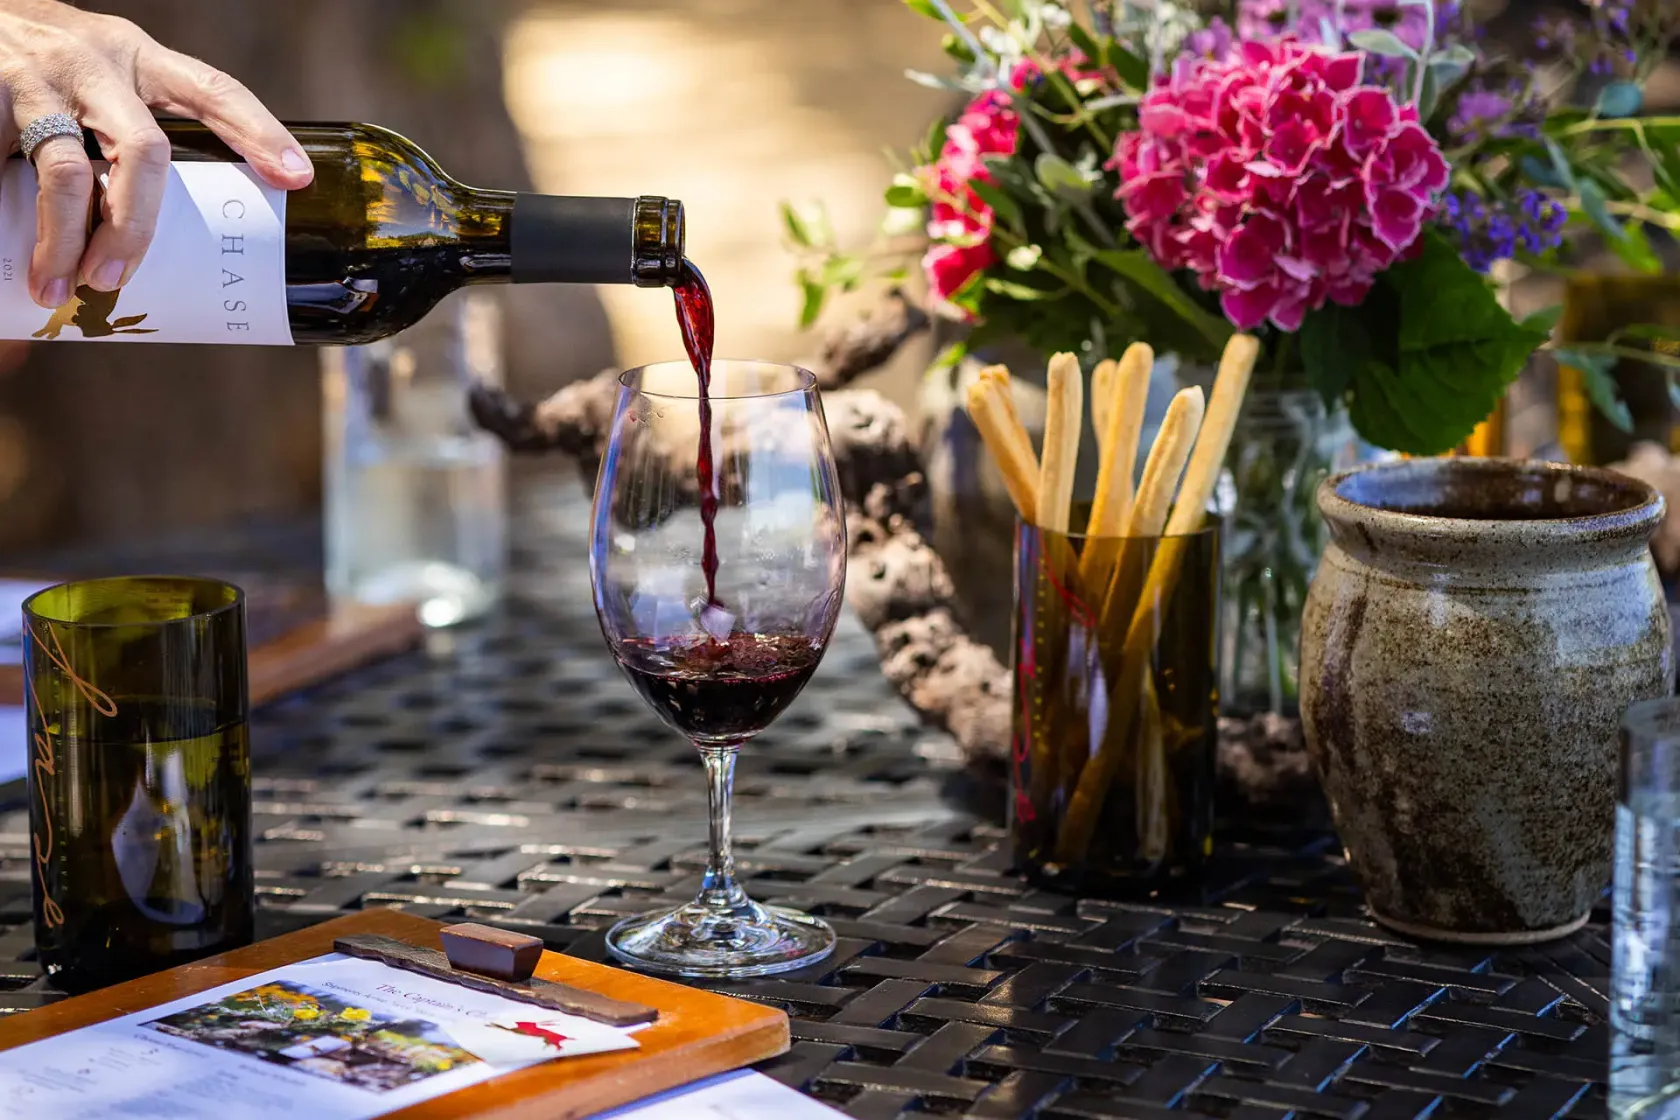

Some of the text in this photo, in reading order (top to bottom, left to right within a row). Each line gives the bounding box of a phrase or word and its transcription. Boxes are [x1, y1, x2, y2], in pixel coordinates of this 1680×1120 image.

[3, 257, 13, 281] 2021
[221, 198, 250, 332] CHASE
[376, 983, 401, 996] The
